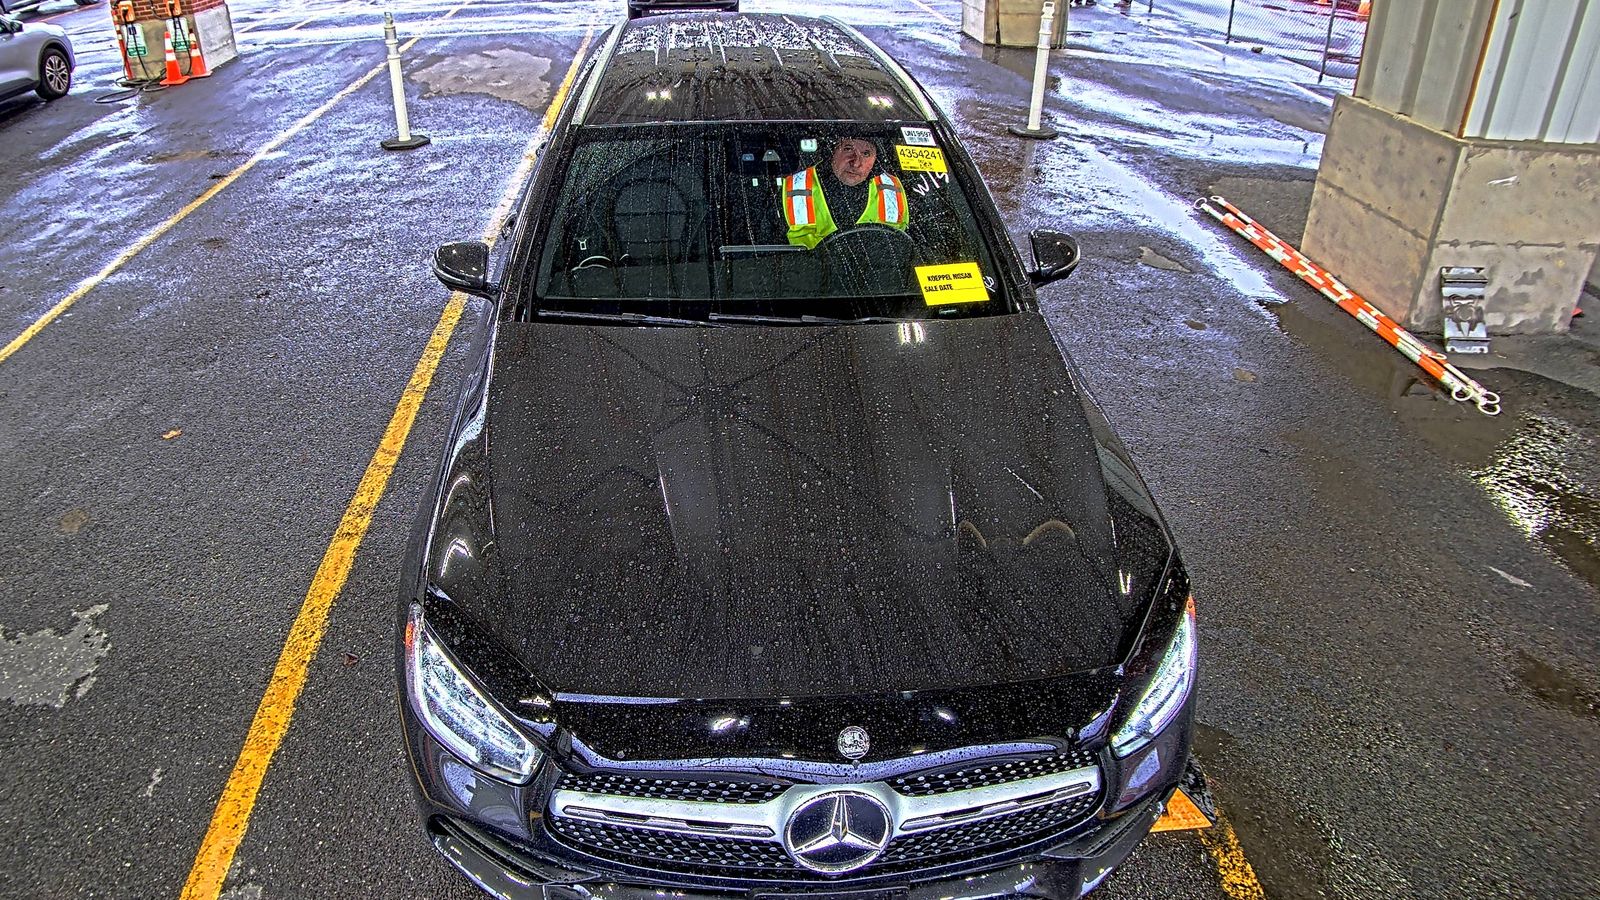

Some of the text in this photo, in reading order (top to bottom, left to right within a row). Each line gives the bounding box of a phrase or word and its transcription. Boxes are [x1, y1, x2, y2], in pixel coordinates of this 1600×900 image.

[899, 148, 942, 161] 4354241
[927, 272, 973, 282] KOEPPEL NISSAN
